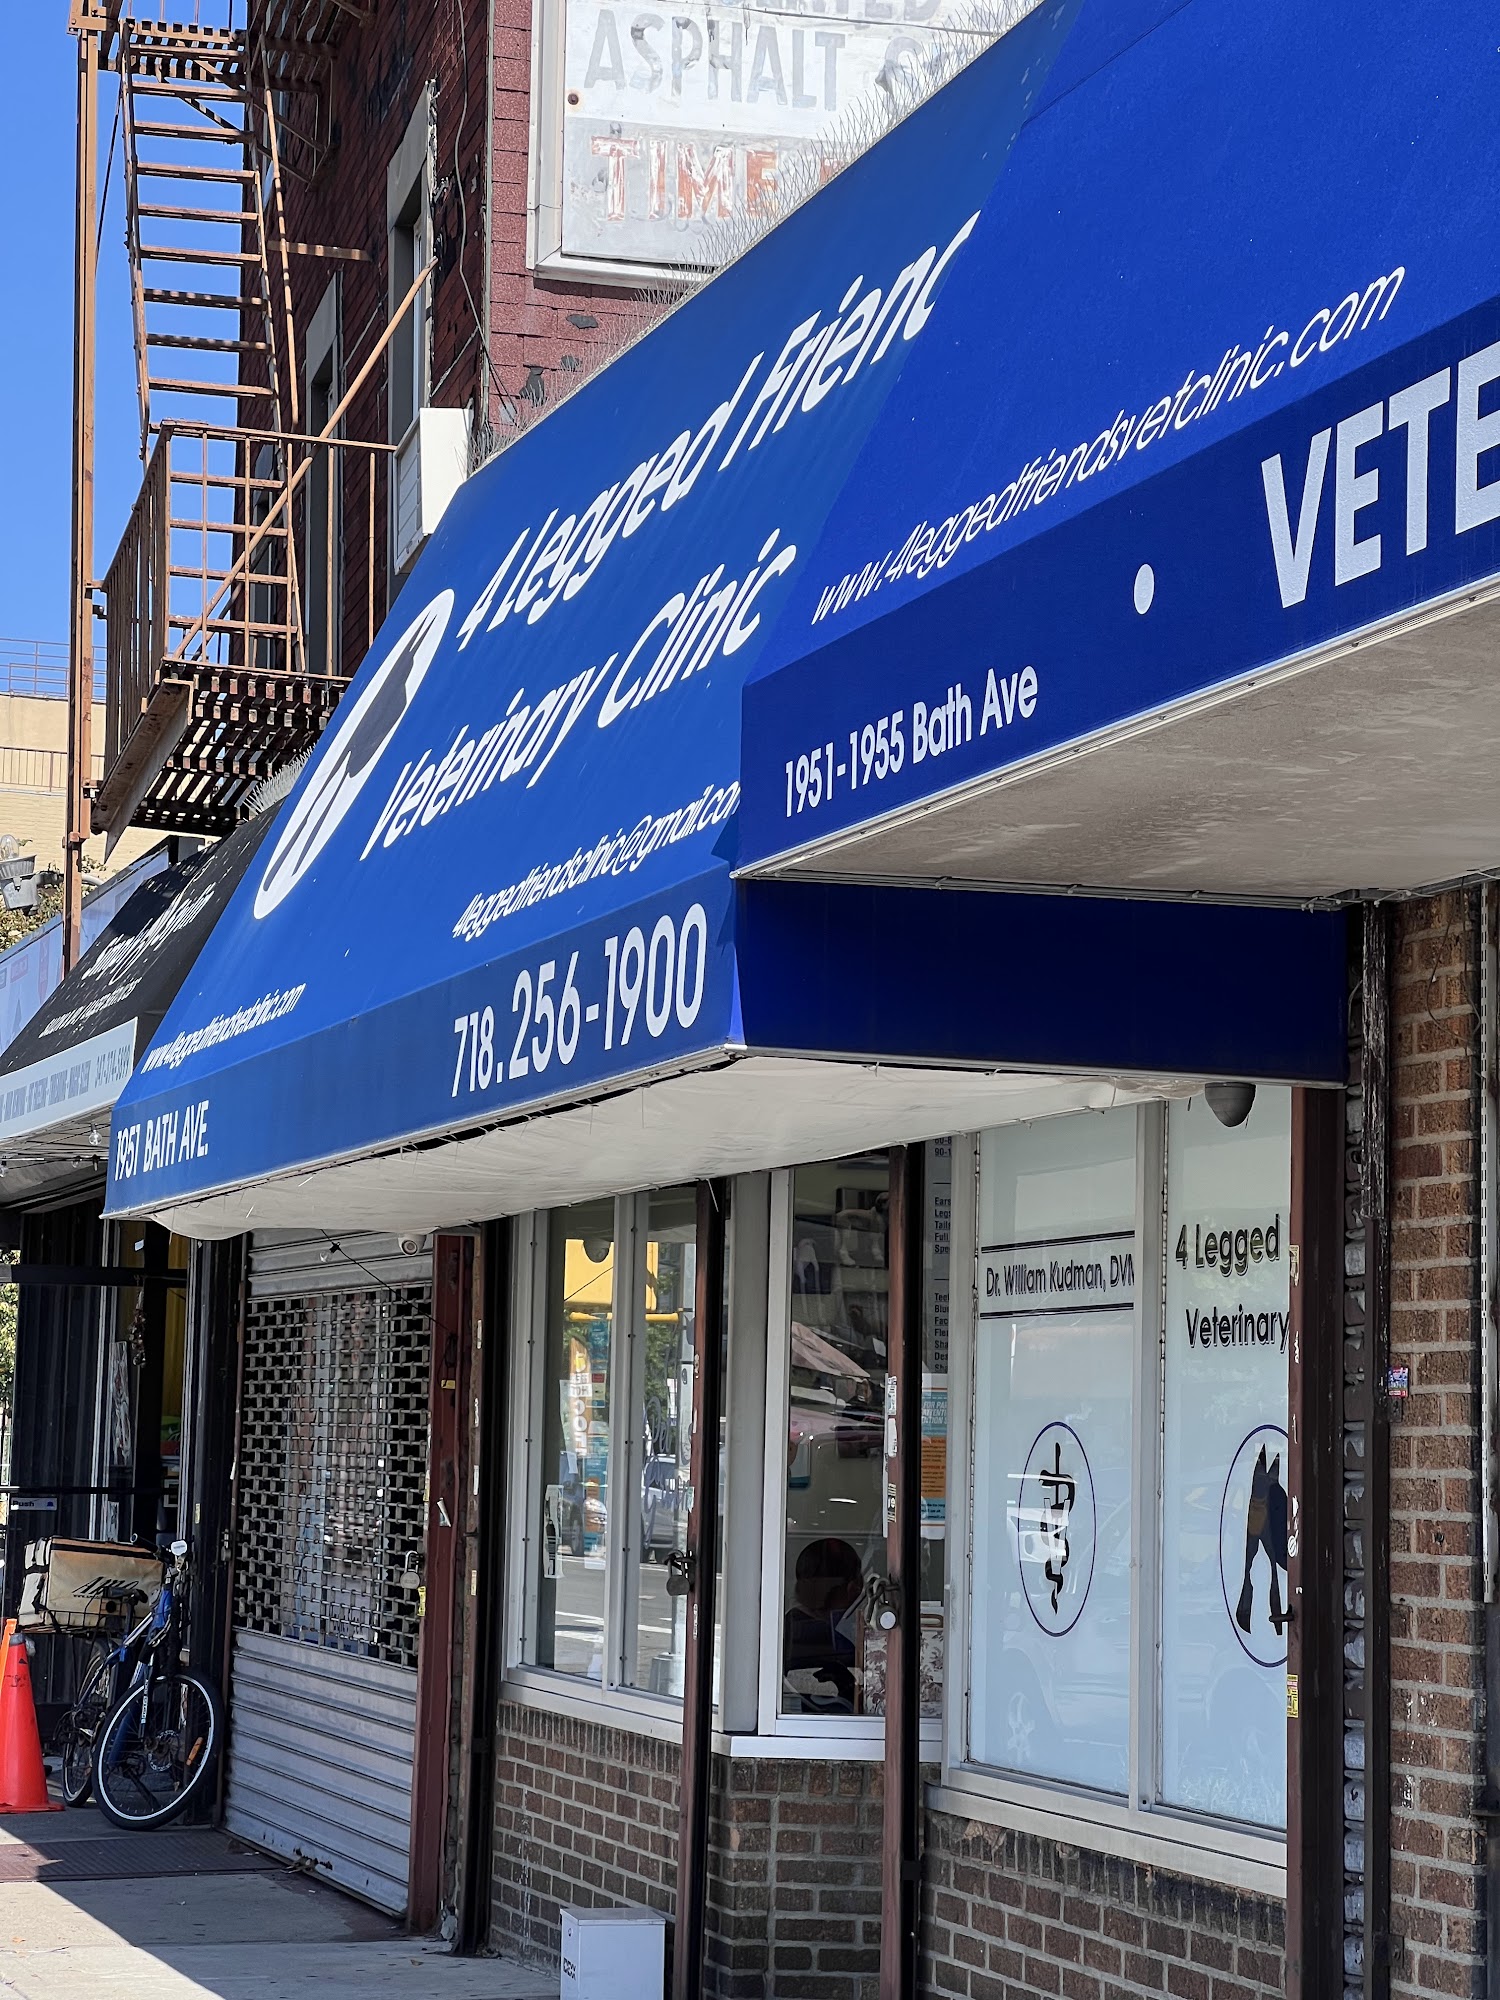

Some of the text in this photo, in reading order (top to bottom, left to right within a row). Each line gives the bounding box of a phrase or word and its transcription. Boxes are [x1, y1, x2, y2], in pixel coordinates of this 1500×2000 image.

[584, 9, 846, 111] ASPHALT
[590, 136, 779, 221] TIME
[488, 351, 763, 630] Legged
[811, 265, 1405, 626] www.4leggedfriendsvetclinic.com
[1261, 341, 1500, 608] VETE
[457, 527, 529, 651] 4
[361, 528, 797, 861] Veterinary Clinic
[785, 664, 1037, 818] 1951-1955 Bath Ave
[452, 903, 707, 1098] 718.256-1900
[115, 1124, 141, 1181] 1951
[143, 1110, 178, 1173] BATH
[986, 1267, 1001, 1297] Dr.
[1004, 1262, 1048, 1296] William
[1049, 1259, 1107, 1293] Kudman,
[1175, 1213, 1281, 1277] 4 Legged
[1186, 1303, 1290, 1354] Veterinary
